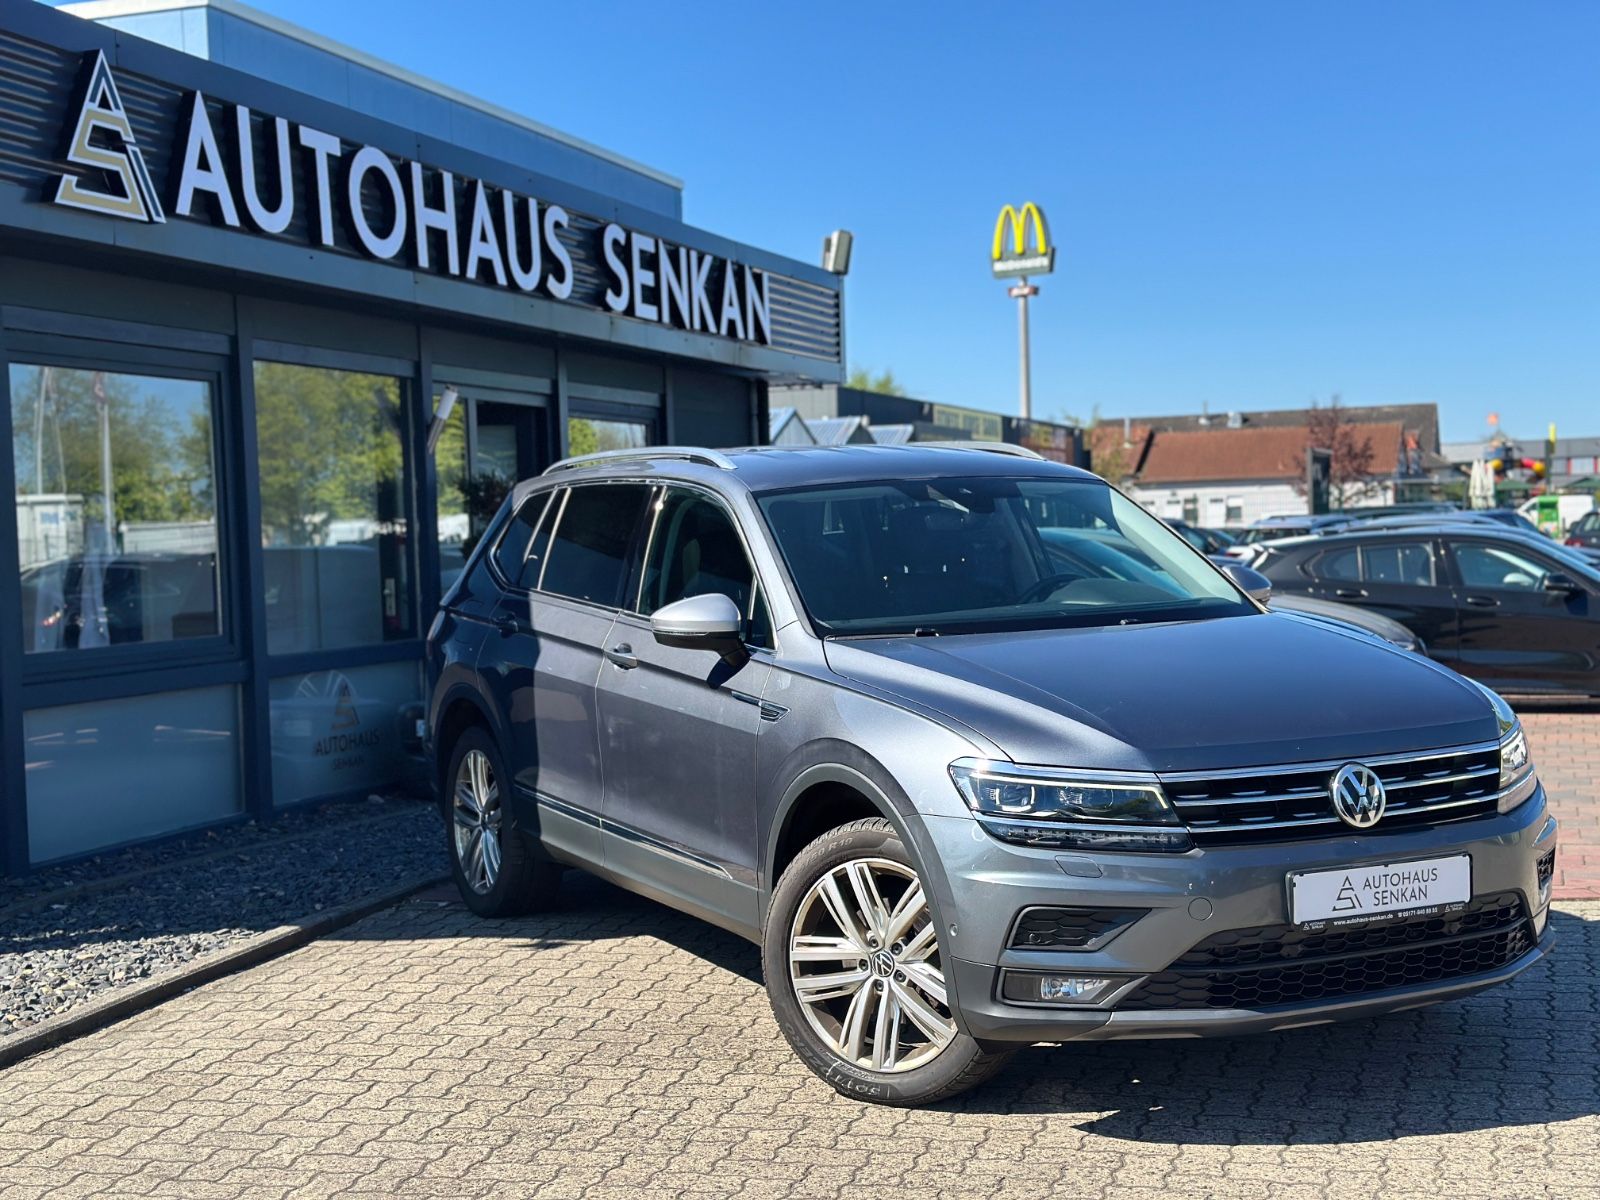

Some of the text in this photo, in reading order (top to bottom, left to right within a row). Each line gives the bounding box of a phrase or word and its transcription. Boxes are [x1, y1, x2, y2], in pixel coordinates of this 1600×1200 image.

[175, 90, 772, 346] AUTOHAUS SENKAN
[314, 728, 380, 757] AUTOHAUS
[1363, 867, 1438, 890] AUTOHAUS
[1373, 885, 1428, 907] SENKAN
[1333, 913, 1394, 926] www.autohaus-senkan.de
